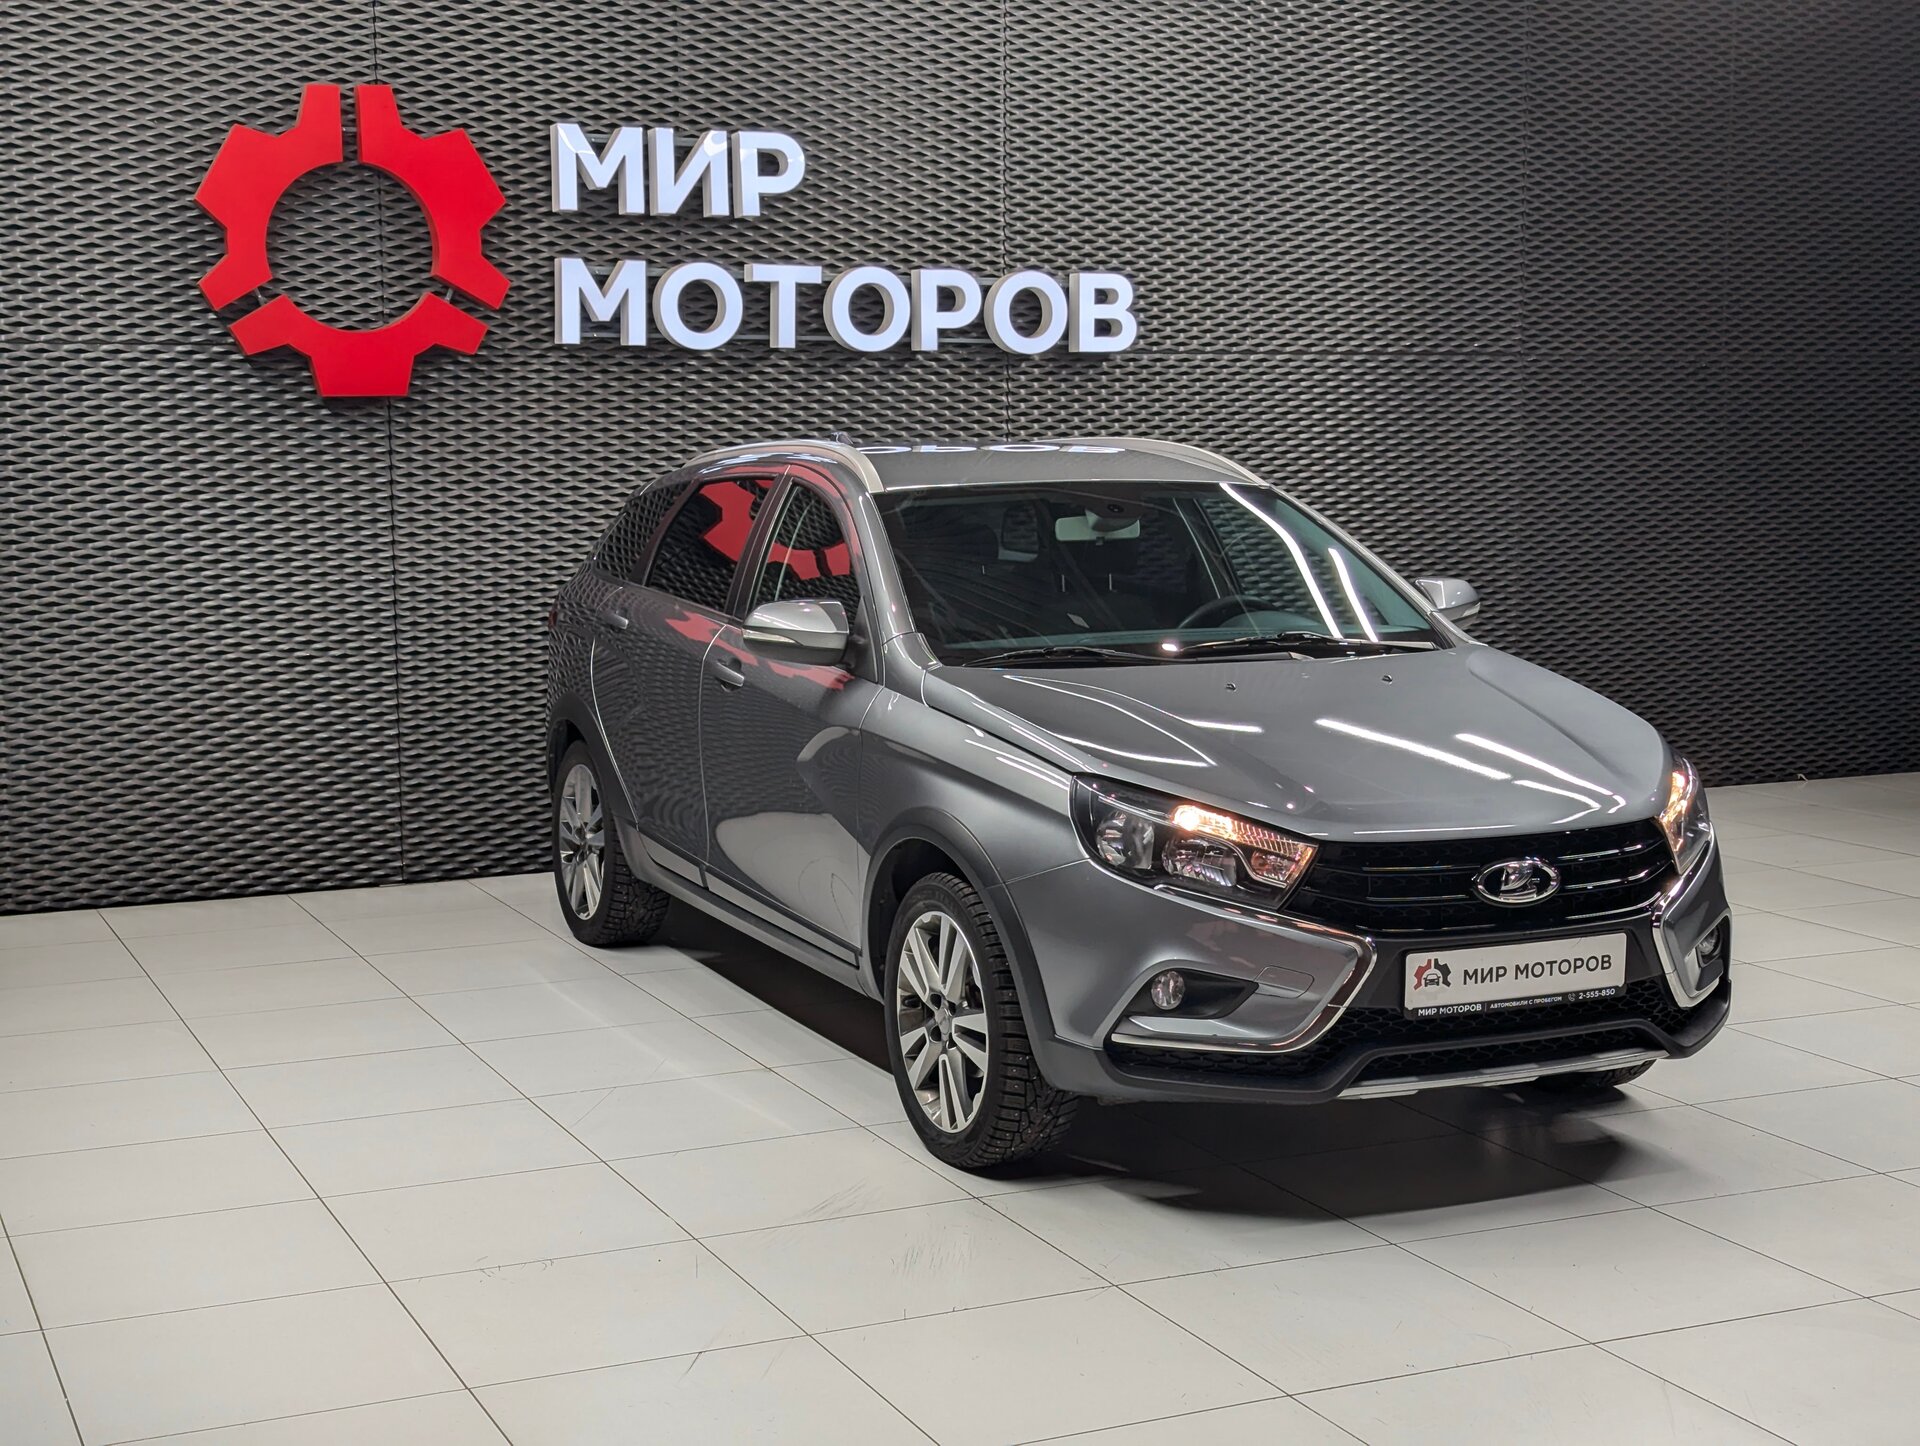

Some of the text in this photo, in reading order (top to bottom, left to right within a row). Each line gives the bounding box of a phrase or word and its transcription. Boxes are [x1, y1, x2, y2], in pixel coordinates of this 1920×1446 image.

[550, 122, 806, 219] МИР
[554, 256, 1138, 355] МОТОРОВ
[1463, 954, 1612, 986] МИР МОТОРОВ
[1418, 1008, 1437, 1017] МИР
[1439, 1003, 1482, 1015] МОТОРОВ
[1490, 999, 1528, 1009] АВТОМОБИЛИ
[1533, 996, 1563, 1004] ПРОБЕГОМ
[1578, 988, 1616, 1000] 2-555-850
